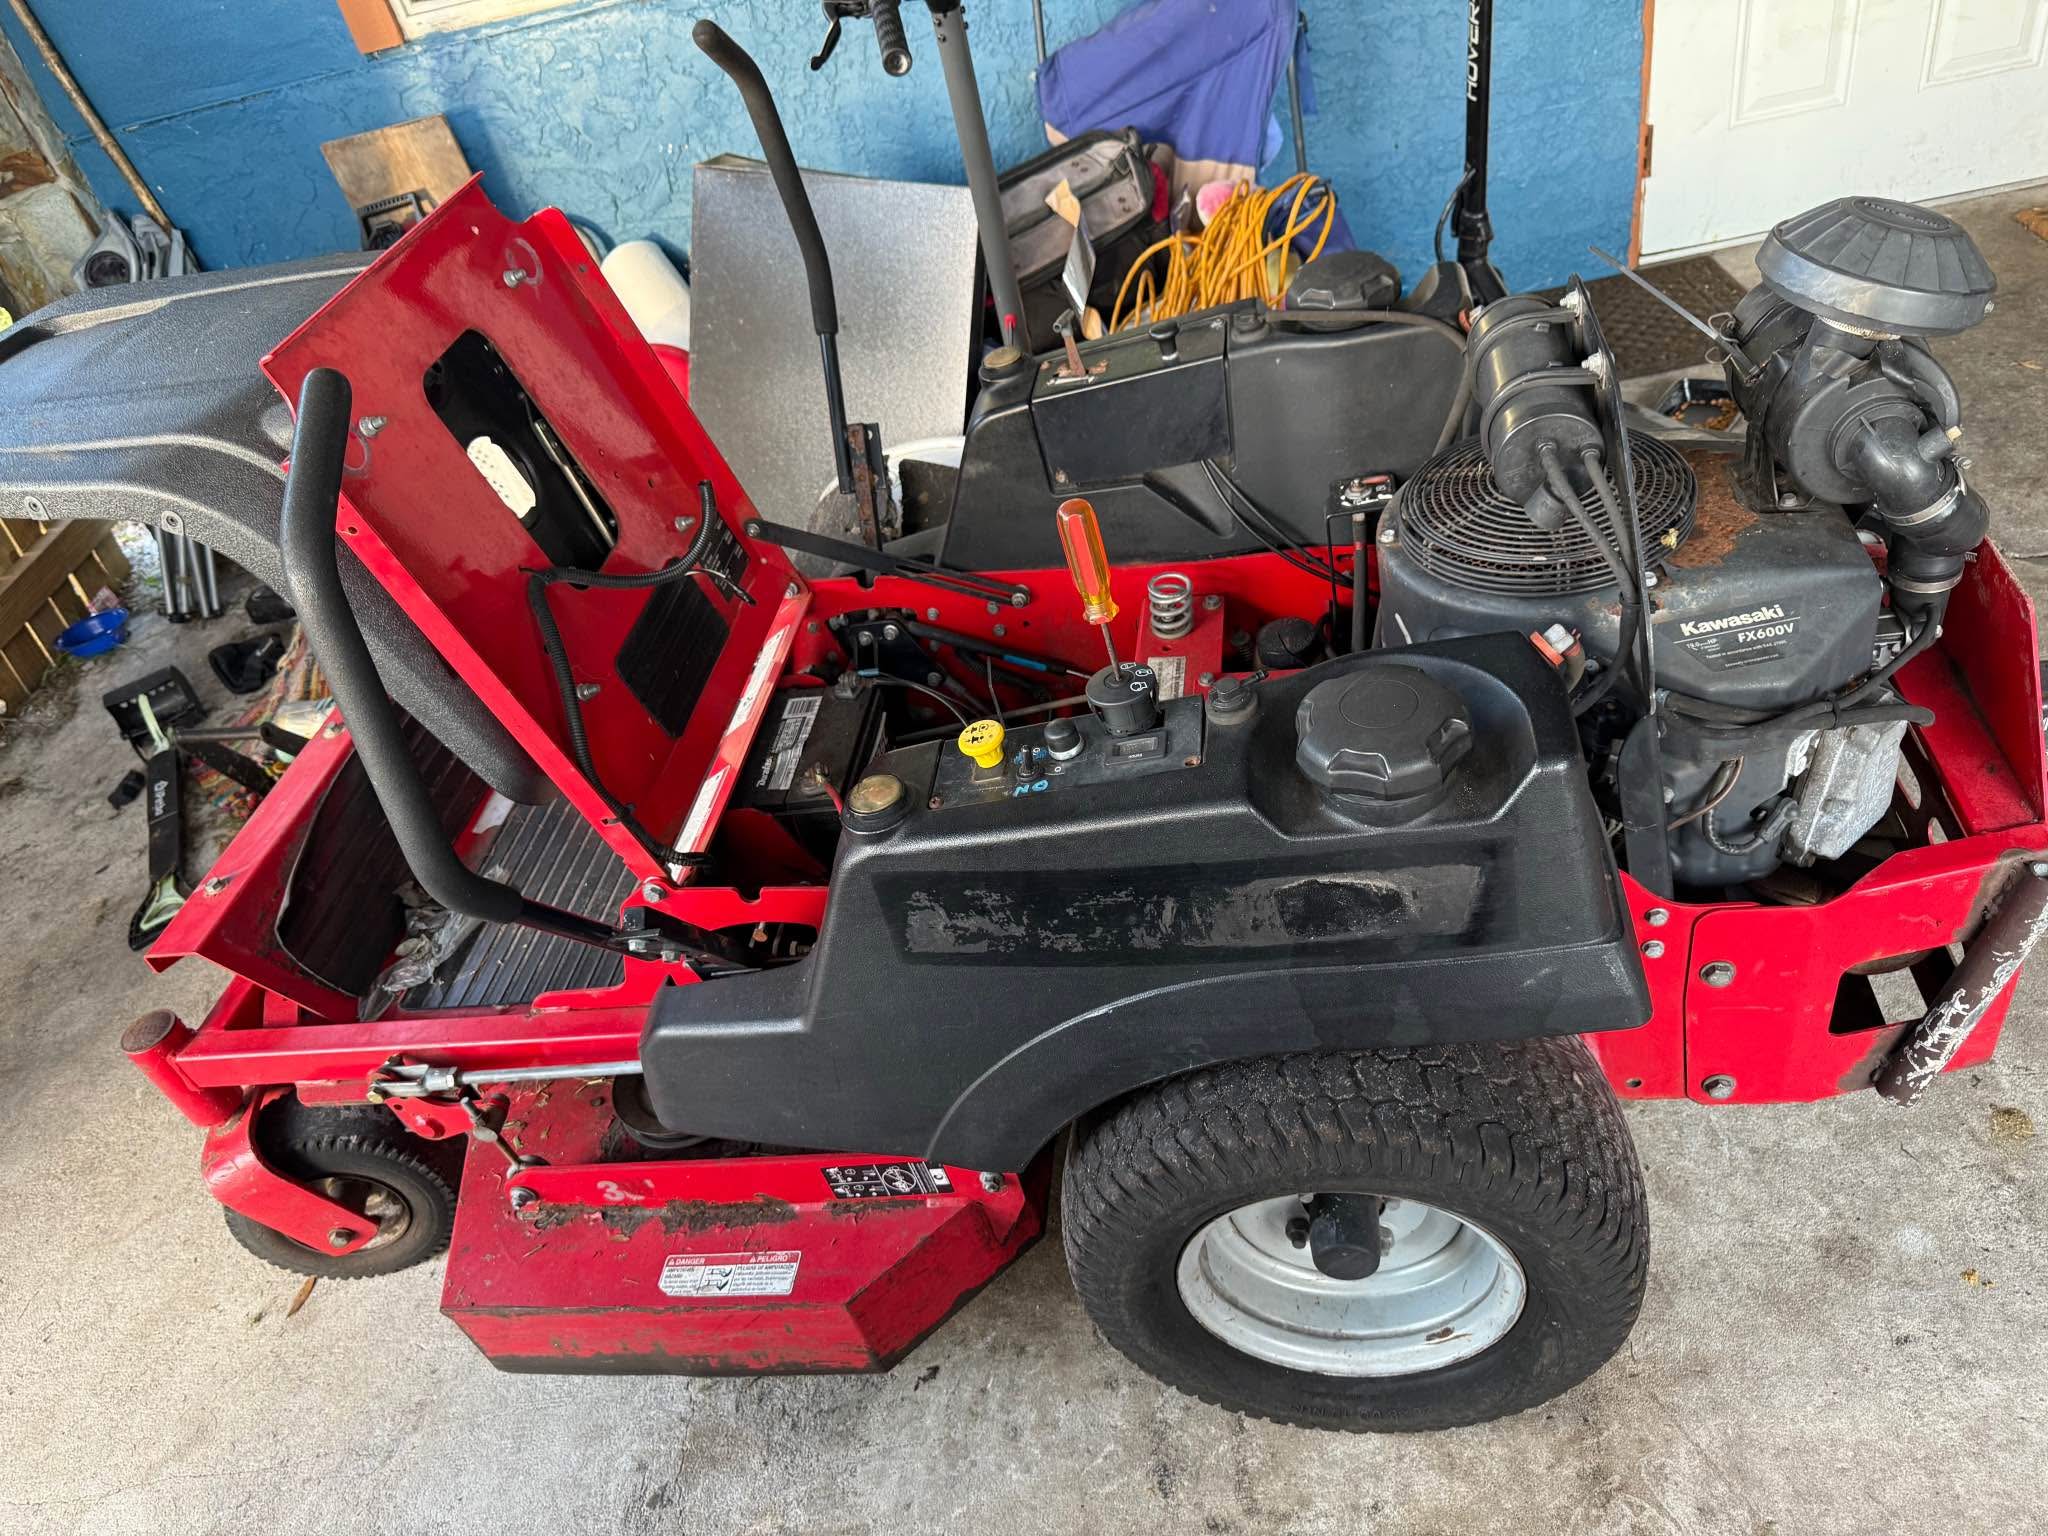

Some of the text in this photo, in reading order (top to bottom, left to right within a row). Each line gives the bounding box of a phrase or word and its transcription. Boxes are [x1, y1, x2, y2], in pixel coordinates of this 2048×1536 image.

[1680, 604, 1785, 637] Kawasaki
[1737, 622, 1795, 643] FX600V
[757, 1255, 788, 1263] PELIGRO
